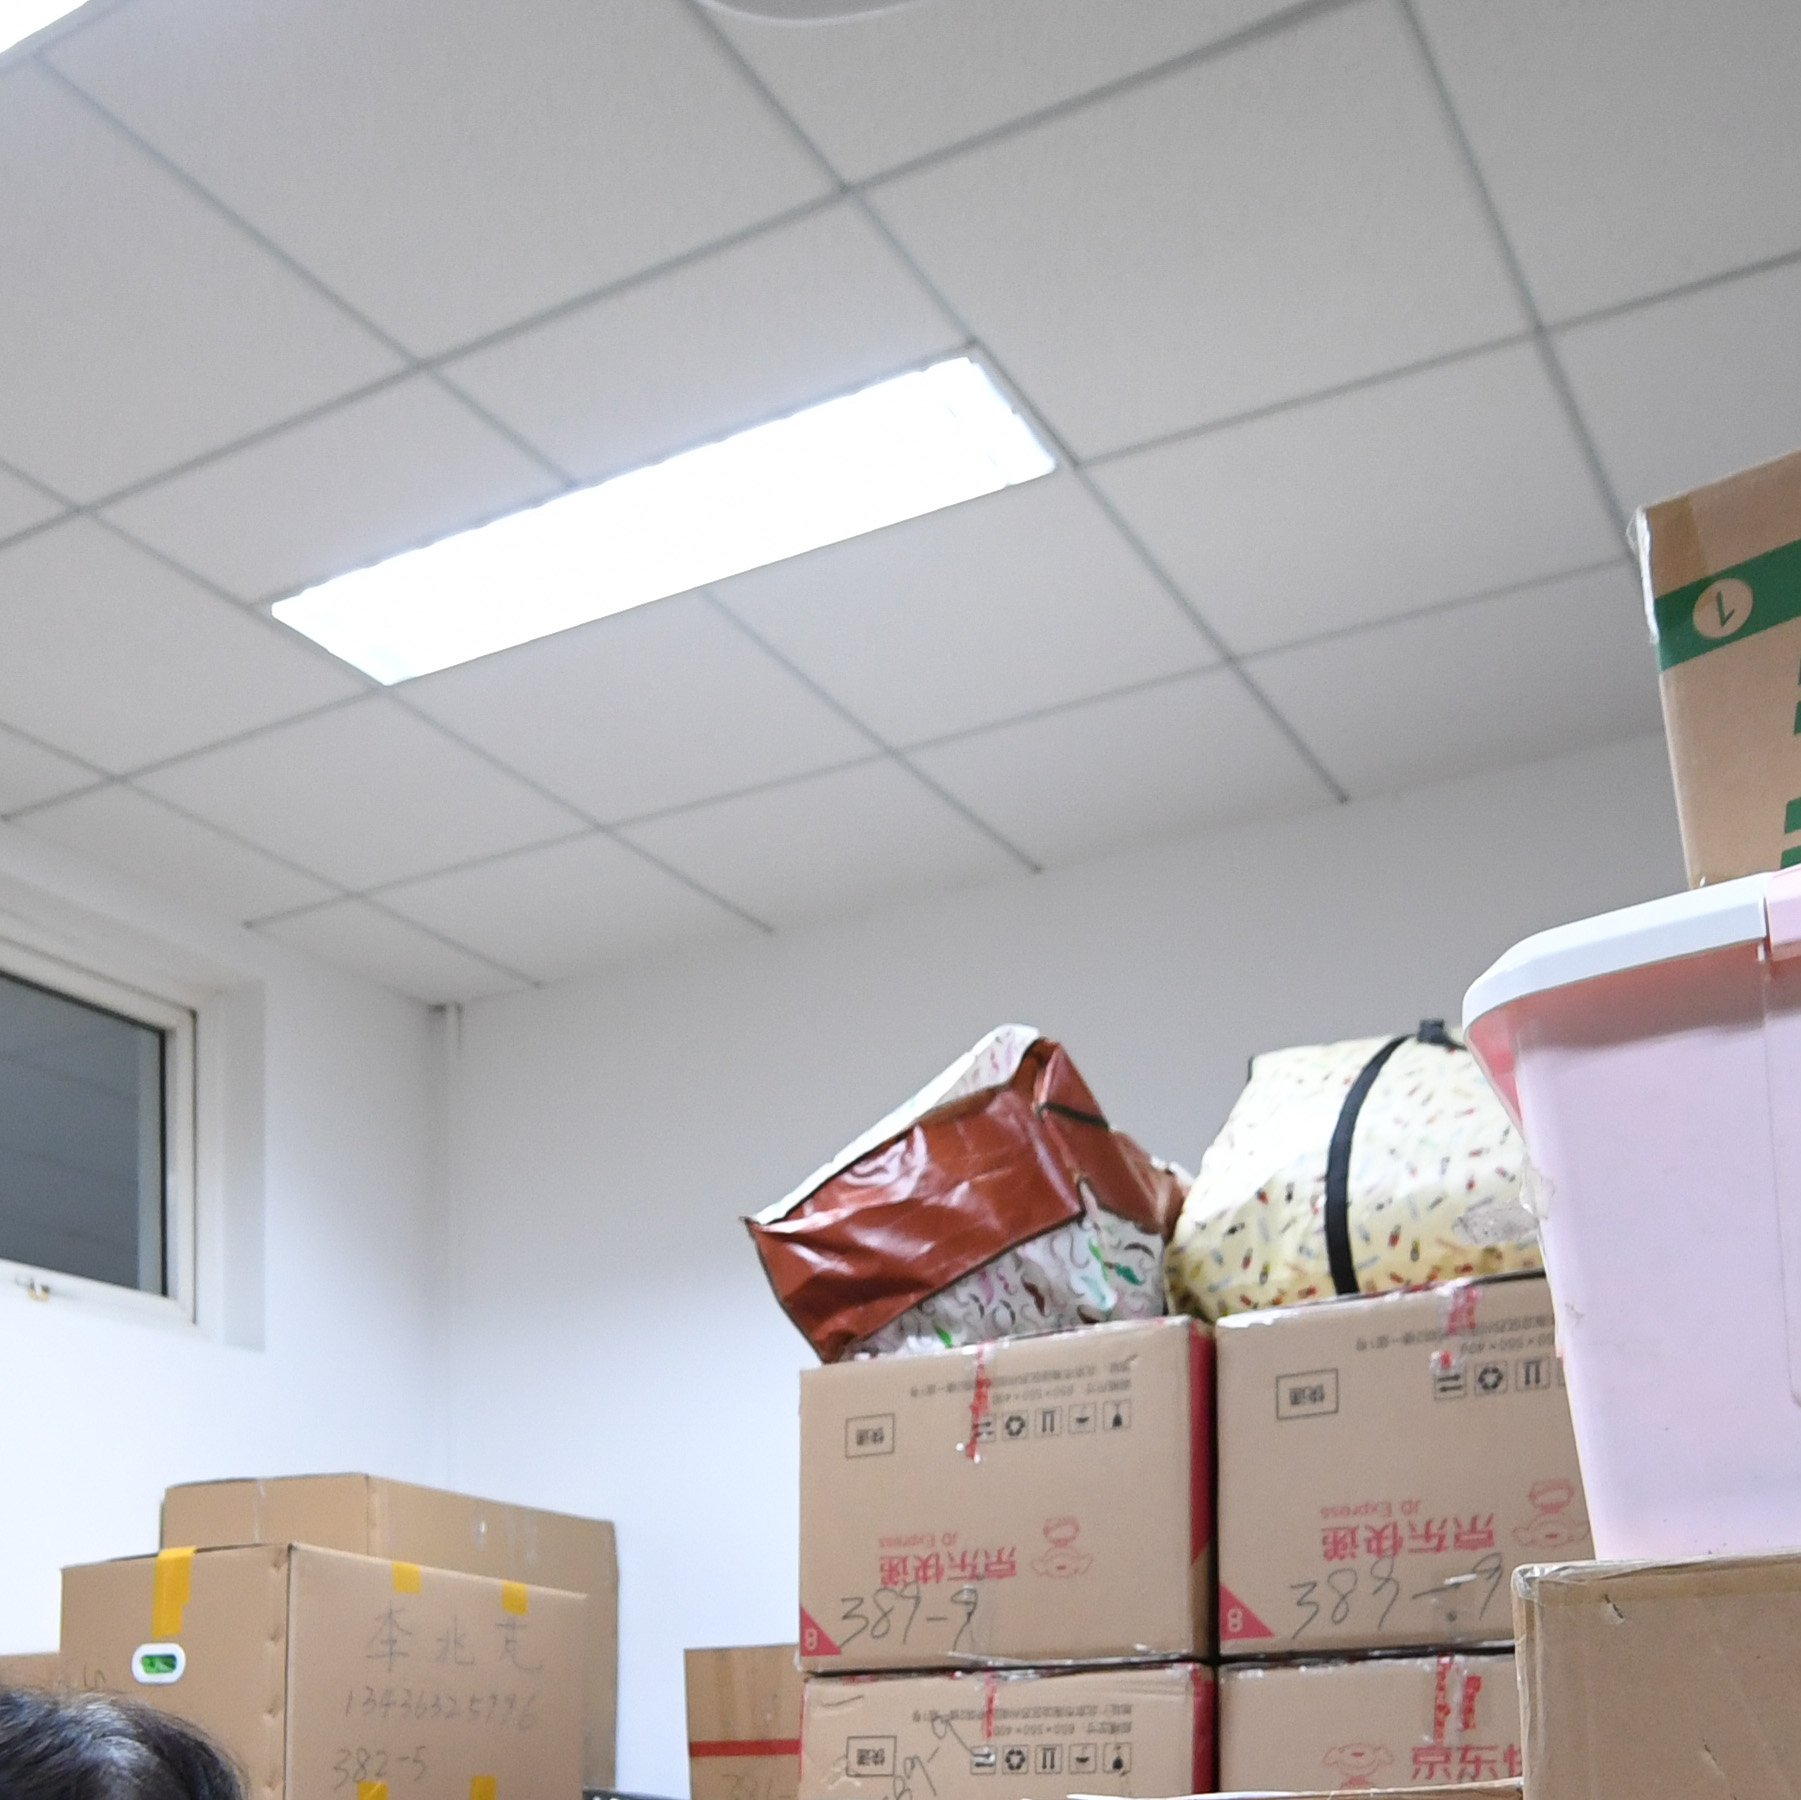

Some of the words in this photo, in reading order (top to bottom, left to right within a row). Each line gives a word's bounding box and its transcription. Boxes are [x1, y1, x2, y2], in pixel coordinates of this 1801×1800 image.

[1320, 1500, 1392, 1521] Express
[1321, 1512, 1495, 1562] 京东快递
[880, 1546, 1017, 1588] 京东快递
[839, 1582, 978, 1653] 389-9
